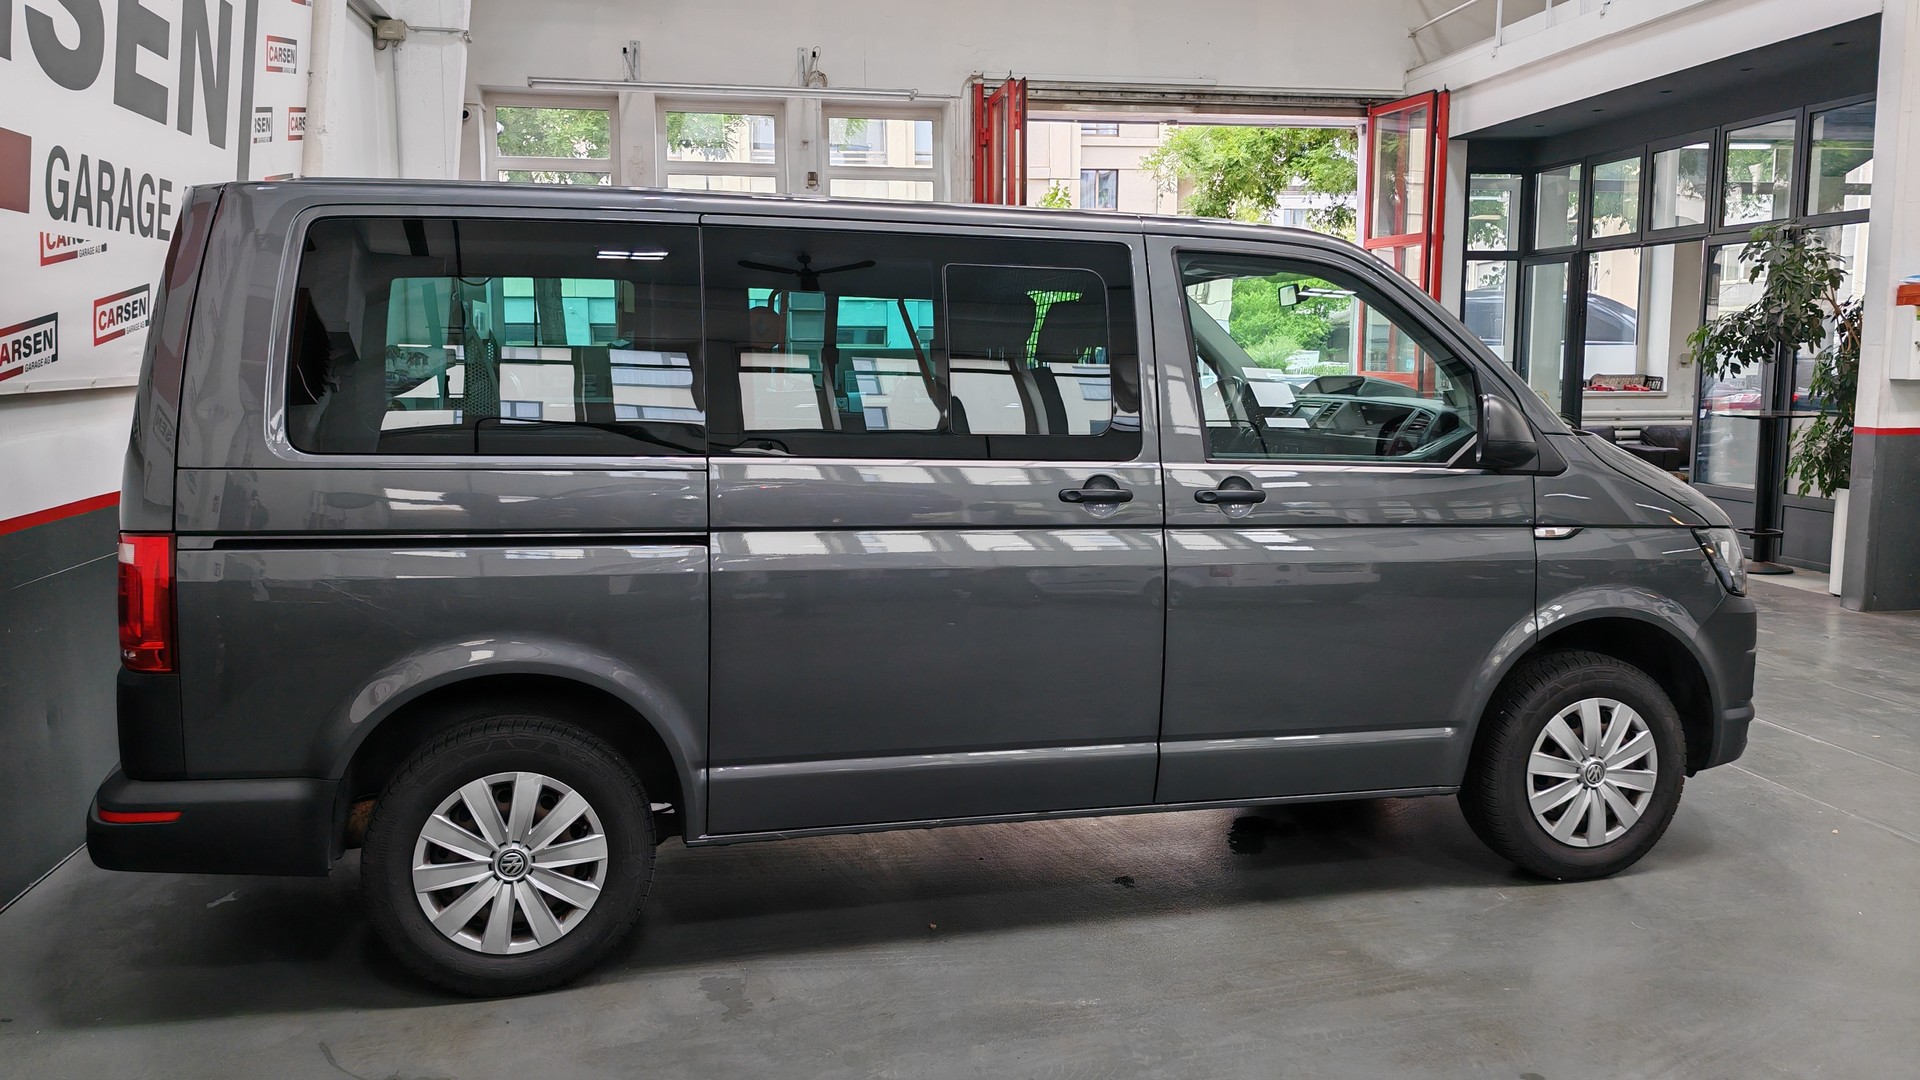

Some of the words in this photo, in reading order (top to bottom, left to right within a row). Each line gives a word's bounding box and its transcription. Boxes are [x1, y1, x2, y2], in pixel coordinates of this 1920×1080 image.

[269, 45, 295, 64] CARSEN
[45, 145, 173, 240] GARAGE
[98, 297, 147, 331] CARSEN
[24, 358, 44, 373] GARAGE
[43, 355, 51, 365] AG
